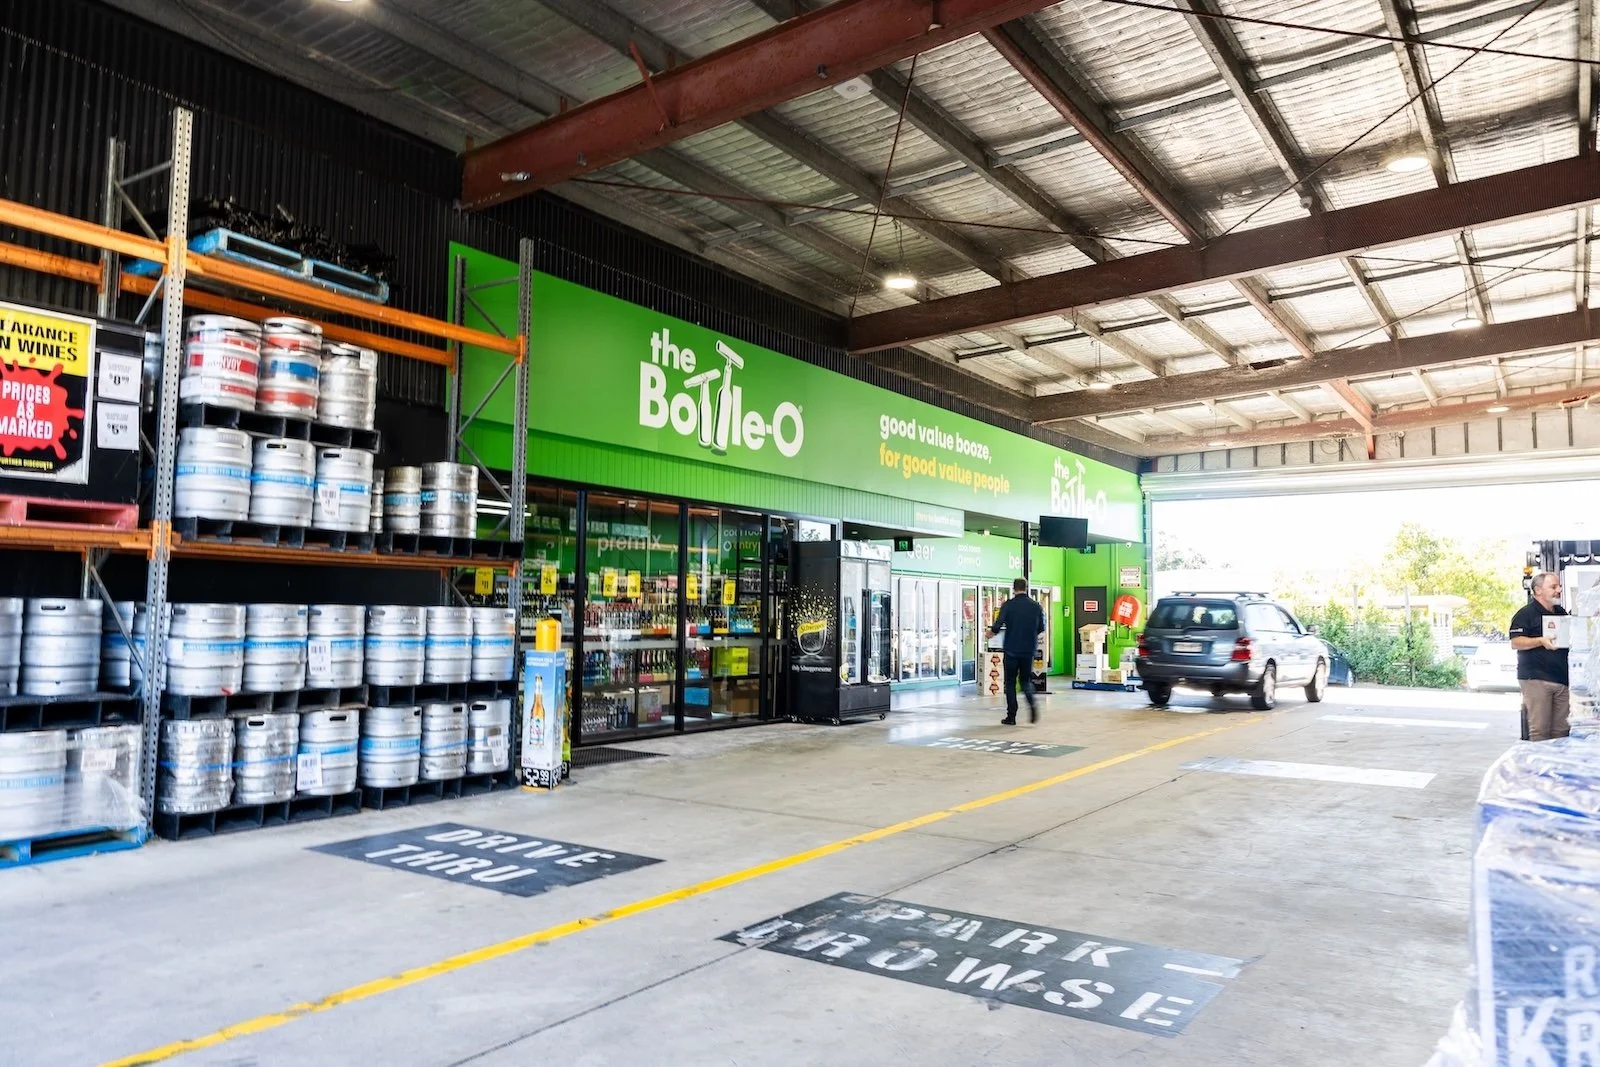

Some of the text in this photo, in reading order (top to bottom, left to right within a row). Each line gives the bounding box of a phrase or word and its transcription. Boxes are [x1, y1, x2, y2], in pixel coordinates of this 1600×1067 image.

[17, 338, 78, 362] WINES
[650, 327, 697, 374] the
[2, 380, 51, 405] PRICES
[16, 400, 35, 420] AS
[639, 340, 804, 458] Bottle-O
[0, 416, 53, 440] MARKED
[879, 414, 992, 464] good value booze,
[879, 442, 1010, 497] for good value people
[1053, 455, 1070, 480] the
[365, 843, 539, 883] THRU
[424, 828, 616, 868] DRIVE
[850, 901, 1134, 968] PARK
